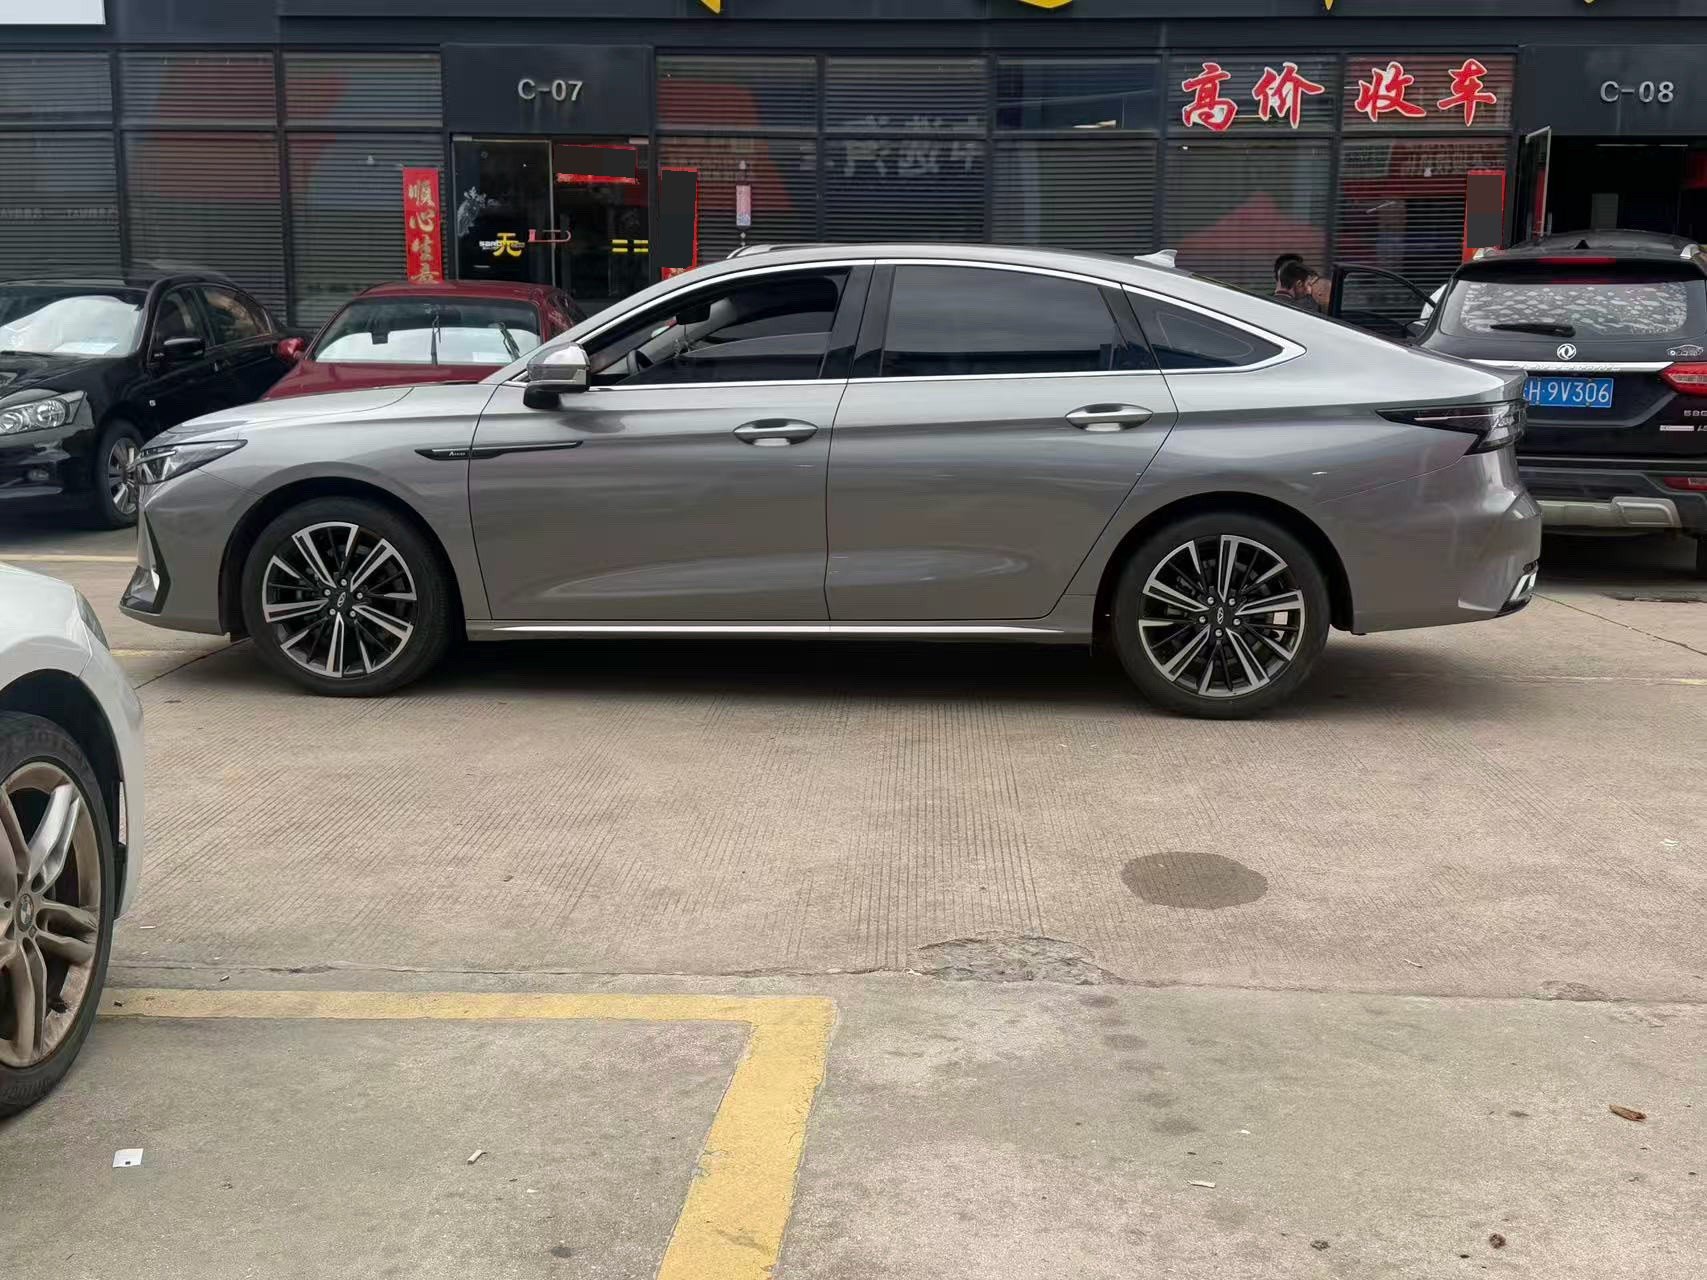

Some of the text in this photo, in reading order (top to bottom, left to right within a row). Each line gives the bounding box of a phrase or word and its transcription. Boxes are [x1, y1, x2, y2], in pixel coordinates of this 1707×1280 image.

[517, 78, 583, 101] C-07
[1182, 58, 1497, 132] 高价收车
[1600, 80, 1674, 103] C-08
